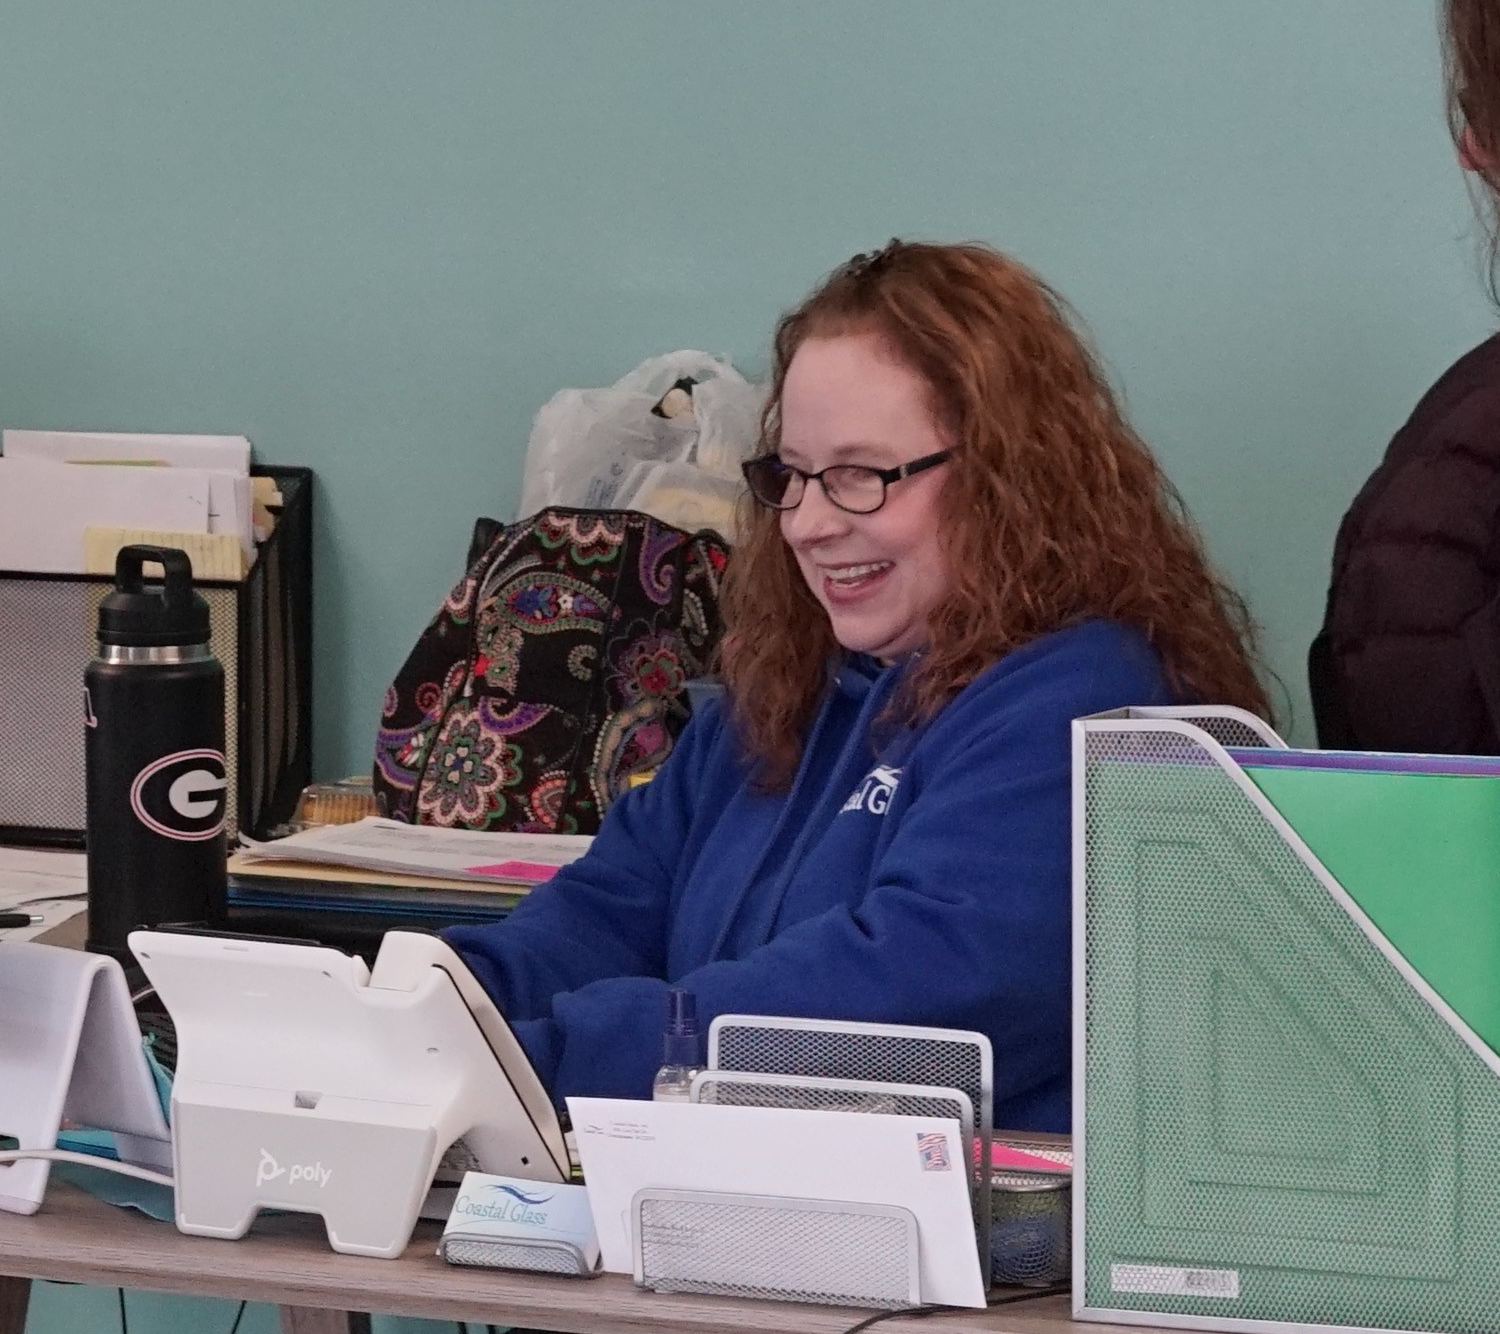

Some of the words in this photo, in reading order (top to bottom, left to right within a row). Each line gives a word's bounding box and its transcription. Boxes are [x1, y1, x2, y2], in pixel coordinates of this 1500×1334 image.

[288, 1161, 333, 1188] poly
[455, 1194, 511, 1220] Coastal
[509, 1202, 549, 1225] Glass
